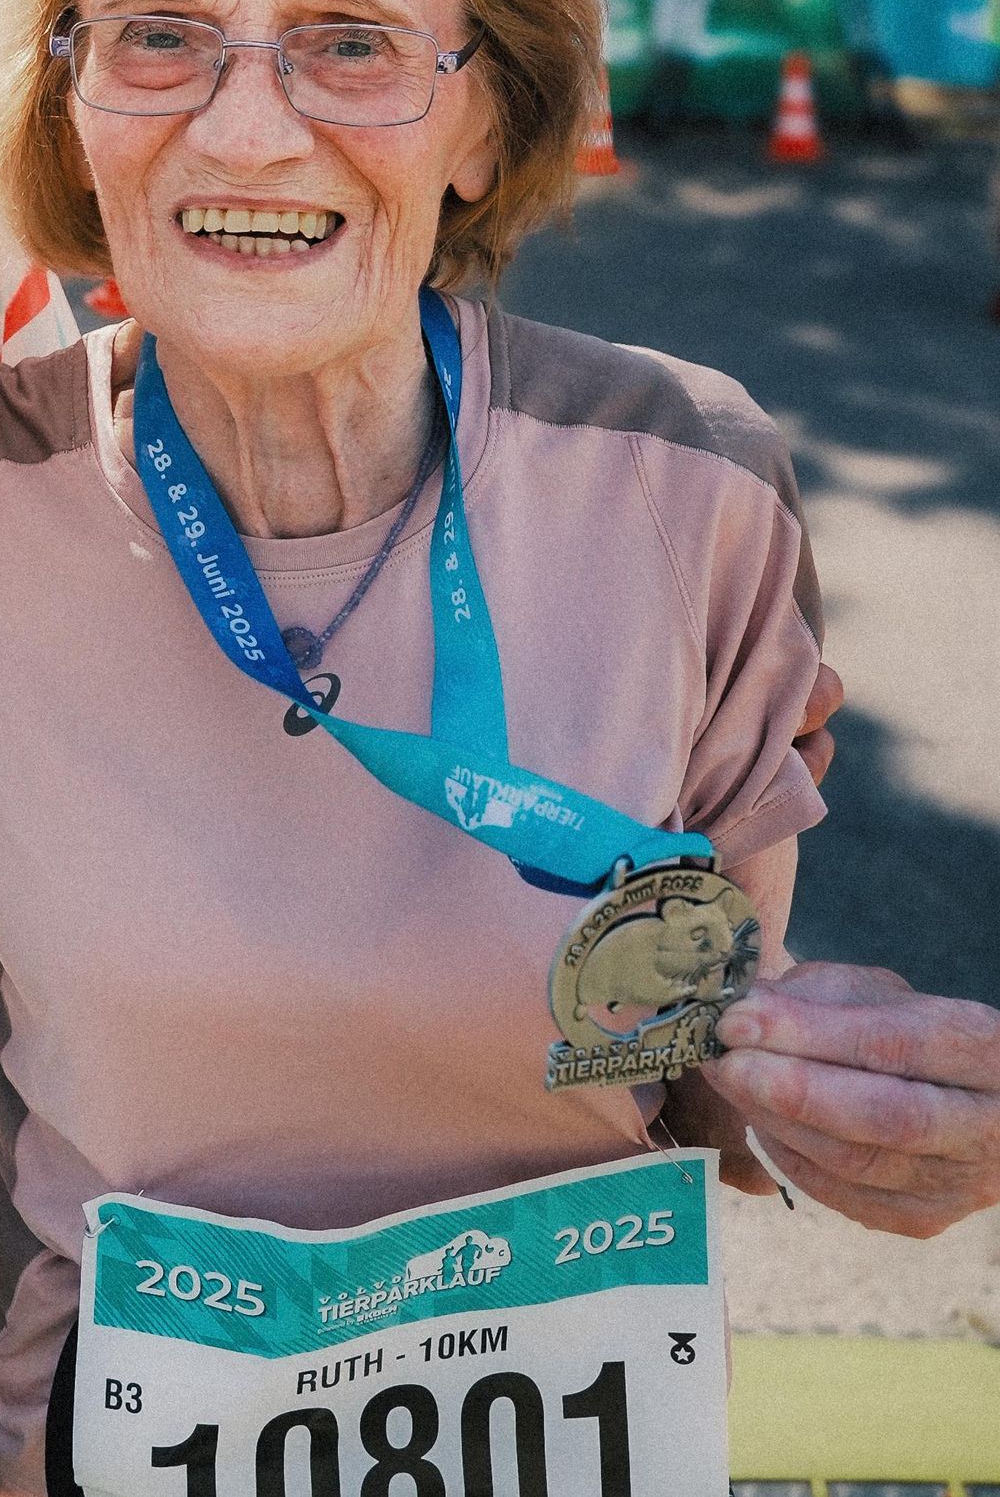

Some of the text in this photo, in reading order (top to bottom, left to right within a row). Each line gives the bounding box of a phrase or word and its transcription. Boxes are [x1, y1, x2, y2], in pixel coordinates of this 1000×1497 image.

[443, 501, 456, 546] 29.
[146, 437, 266, 663] 28. & 29. Juni 2025
[444, 550, 460, 572] &
[453, 577, 472, 624] 28.
[555, 1041, 720, 1082] TIERPARKLAU
[553, 1209, 677, 1266] 2025
[134, 1258, 266, 1319] 2025
[317, 1266, 502, 1325] TIERPARKLAUF
[318, 1274, 402, 1305] VOLVO
[296, 1350, 383, 1396] RUTH
[419, 1324, 509, 1363] 10KM
[104, 1376, 143, 1414] B3
